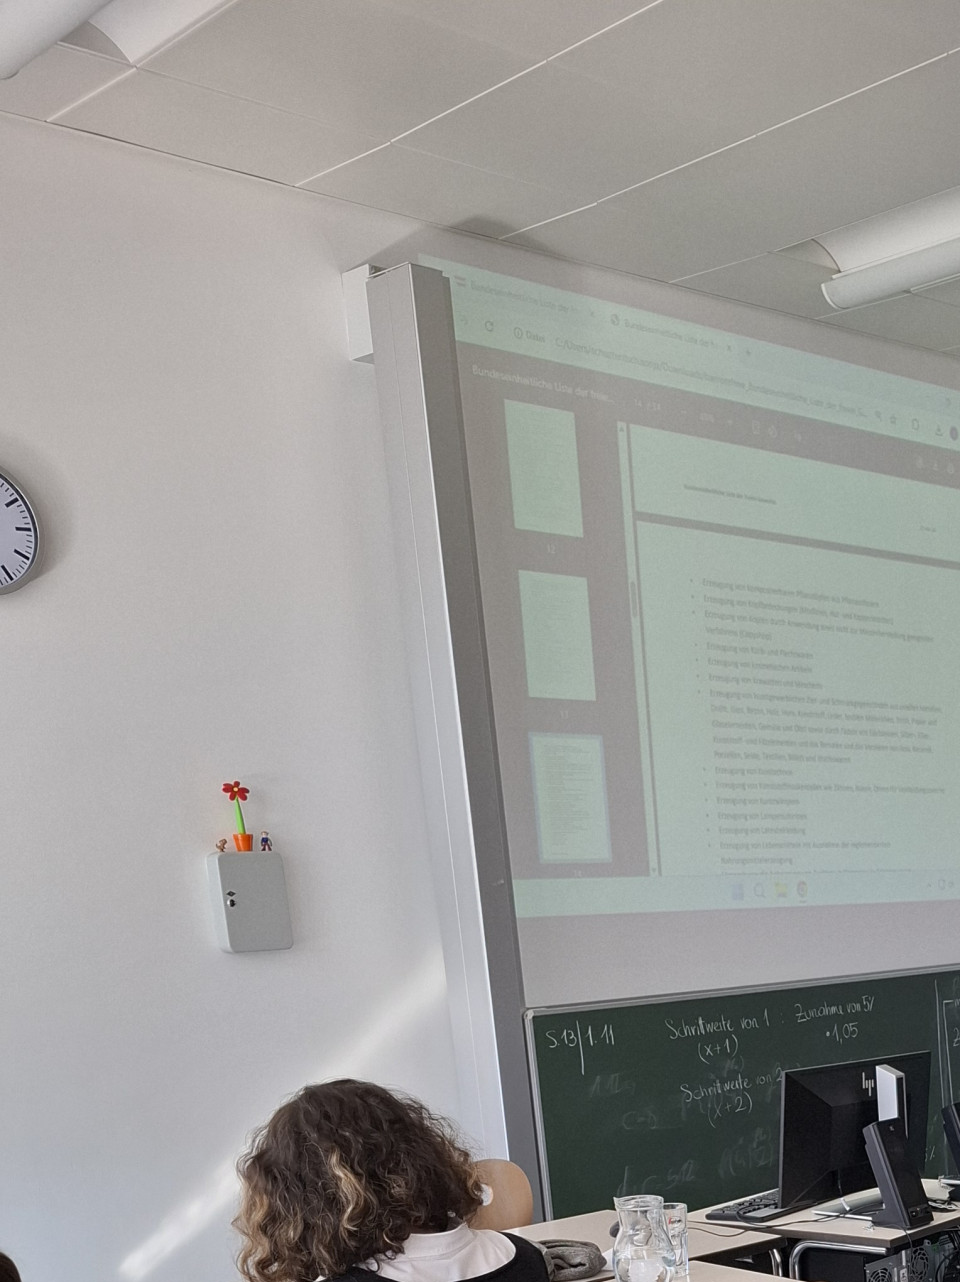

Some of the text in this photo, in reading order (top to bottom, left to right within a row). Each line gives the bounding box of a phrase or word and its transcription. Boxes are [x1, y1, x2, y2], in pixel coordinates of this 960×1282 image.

[794, 1002, 844, 1022] Zunahme
[846, 1001, 861, 1013] von
[740, 1016, 760, 1030] von
